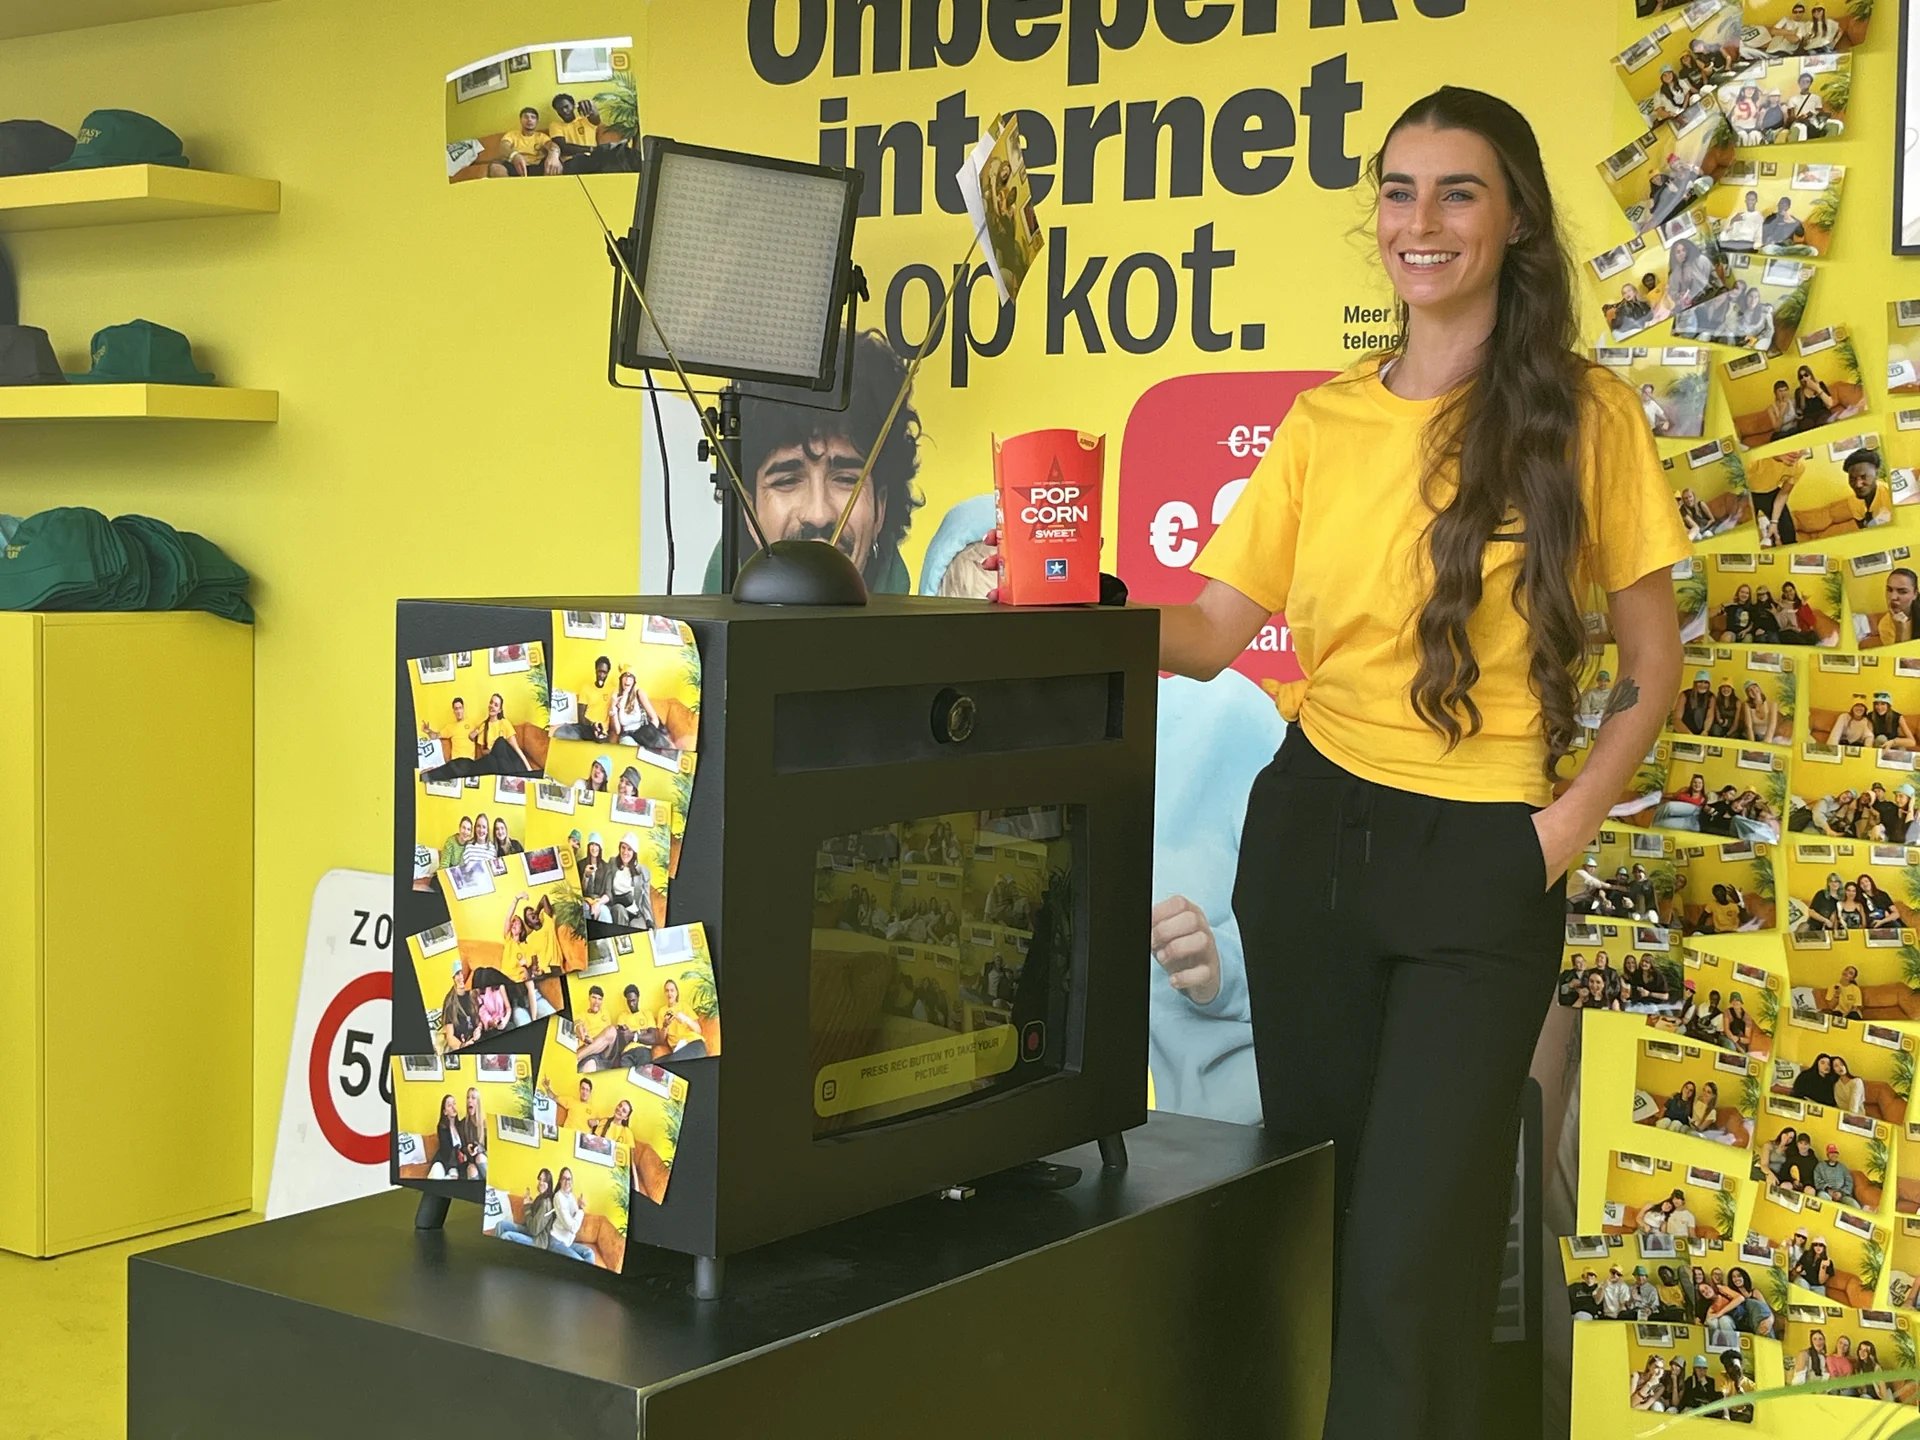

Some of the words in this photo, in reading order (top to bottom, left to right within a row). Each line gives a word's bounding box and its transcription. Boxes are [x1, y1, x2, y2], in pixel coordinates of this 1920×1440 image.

[884, 262, 1016, 388] op
[1045, 221, 1266, 356] kot.
[1343, 305, 1392, 324] Meer
[1030, 487, 1080, 505] POP
[1020, 505, 1088, 524] CORN
[1035, 528, 1077, 539] SWEET
[860, 1063, 889, 1079] PRESS
[890, 1058, 910, 1073] REC
[909, 1050, 943, 1069] BUTTON
[944, 1048, 955, 1060] TO
[957, 1042, 977, 1056] TAKE
[976, 1037, 1000, 1052] YOUR
[914, 1063, 950, 1082] PICTURE
